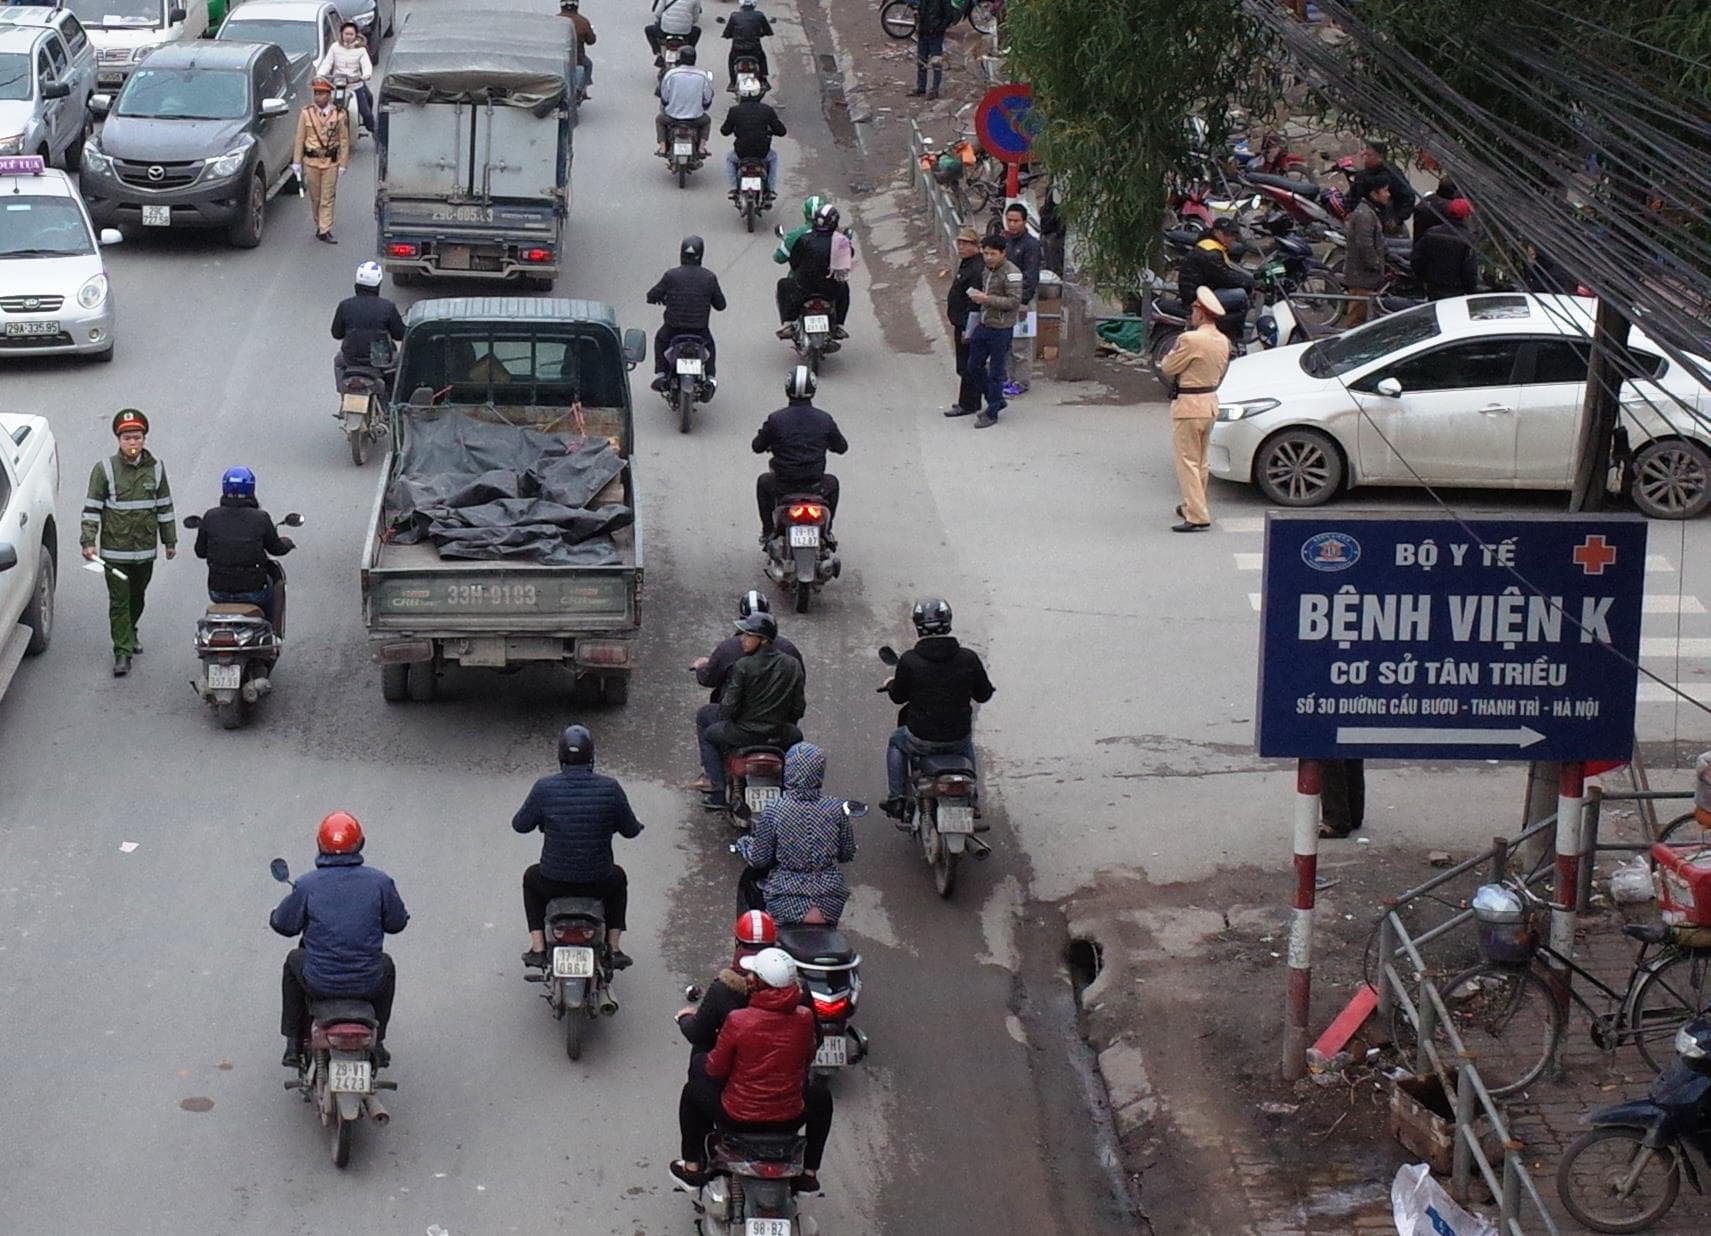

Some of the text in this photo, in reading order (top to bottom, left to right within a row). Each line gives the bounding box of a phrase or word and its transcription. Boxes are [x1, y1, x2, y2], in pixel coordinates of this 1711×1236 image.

[1395, 536, 1519, 571] BỘ Y TẾ
[1298, 584, 1615, 650] BỆNH VIỆN K
[1330, 652, 1567, 686] CƠ SỞ TÂN TRIỀU
[1296, 691, 1316, 715] SỐ
[1318, 697, 1336, 715] 30
[1470, 698, 1515, 716] THANH
[1519, 695, 1540, 716] TRÌ
[1552, 696, 1571, 717] HÀ
[1575, 696, 1600, 720] NỘI
